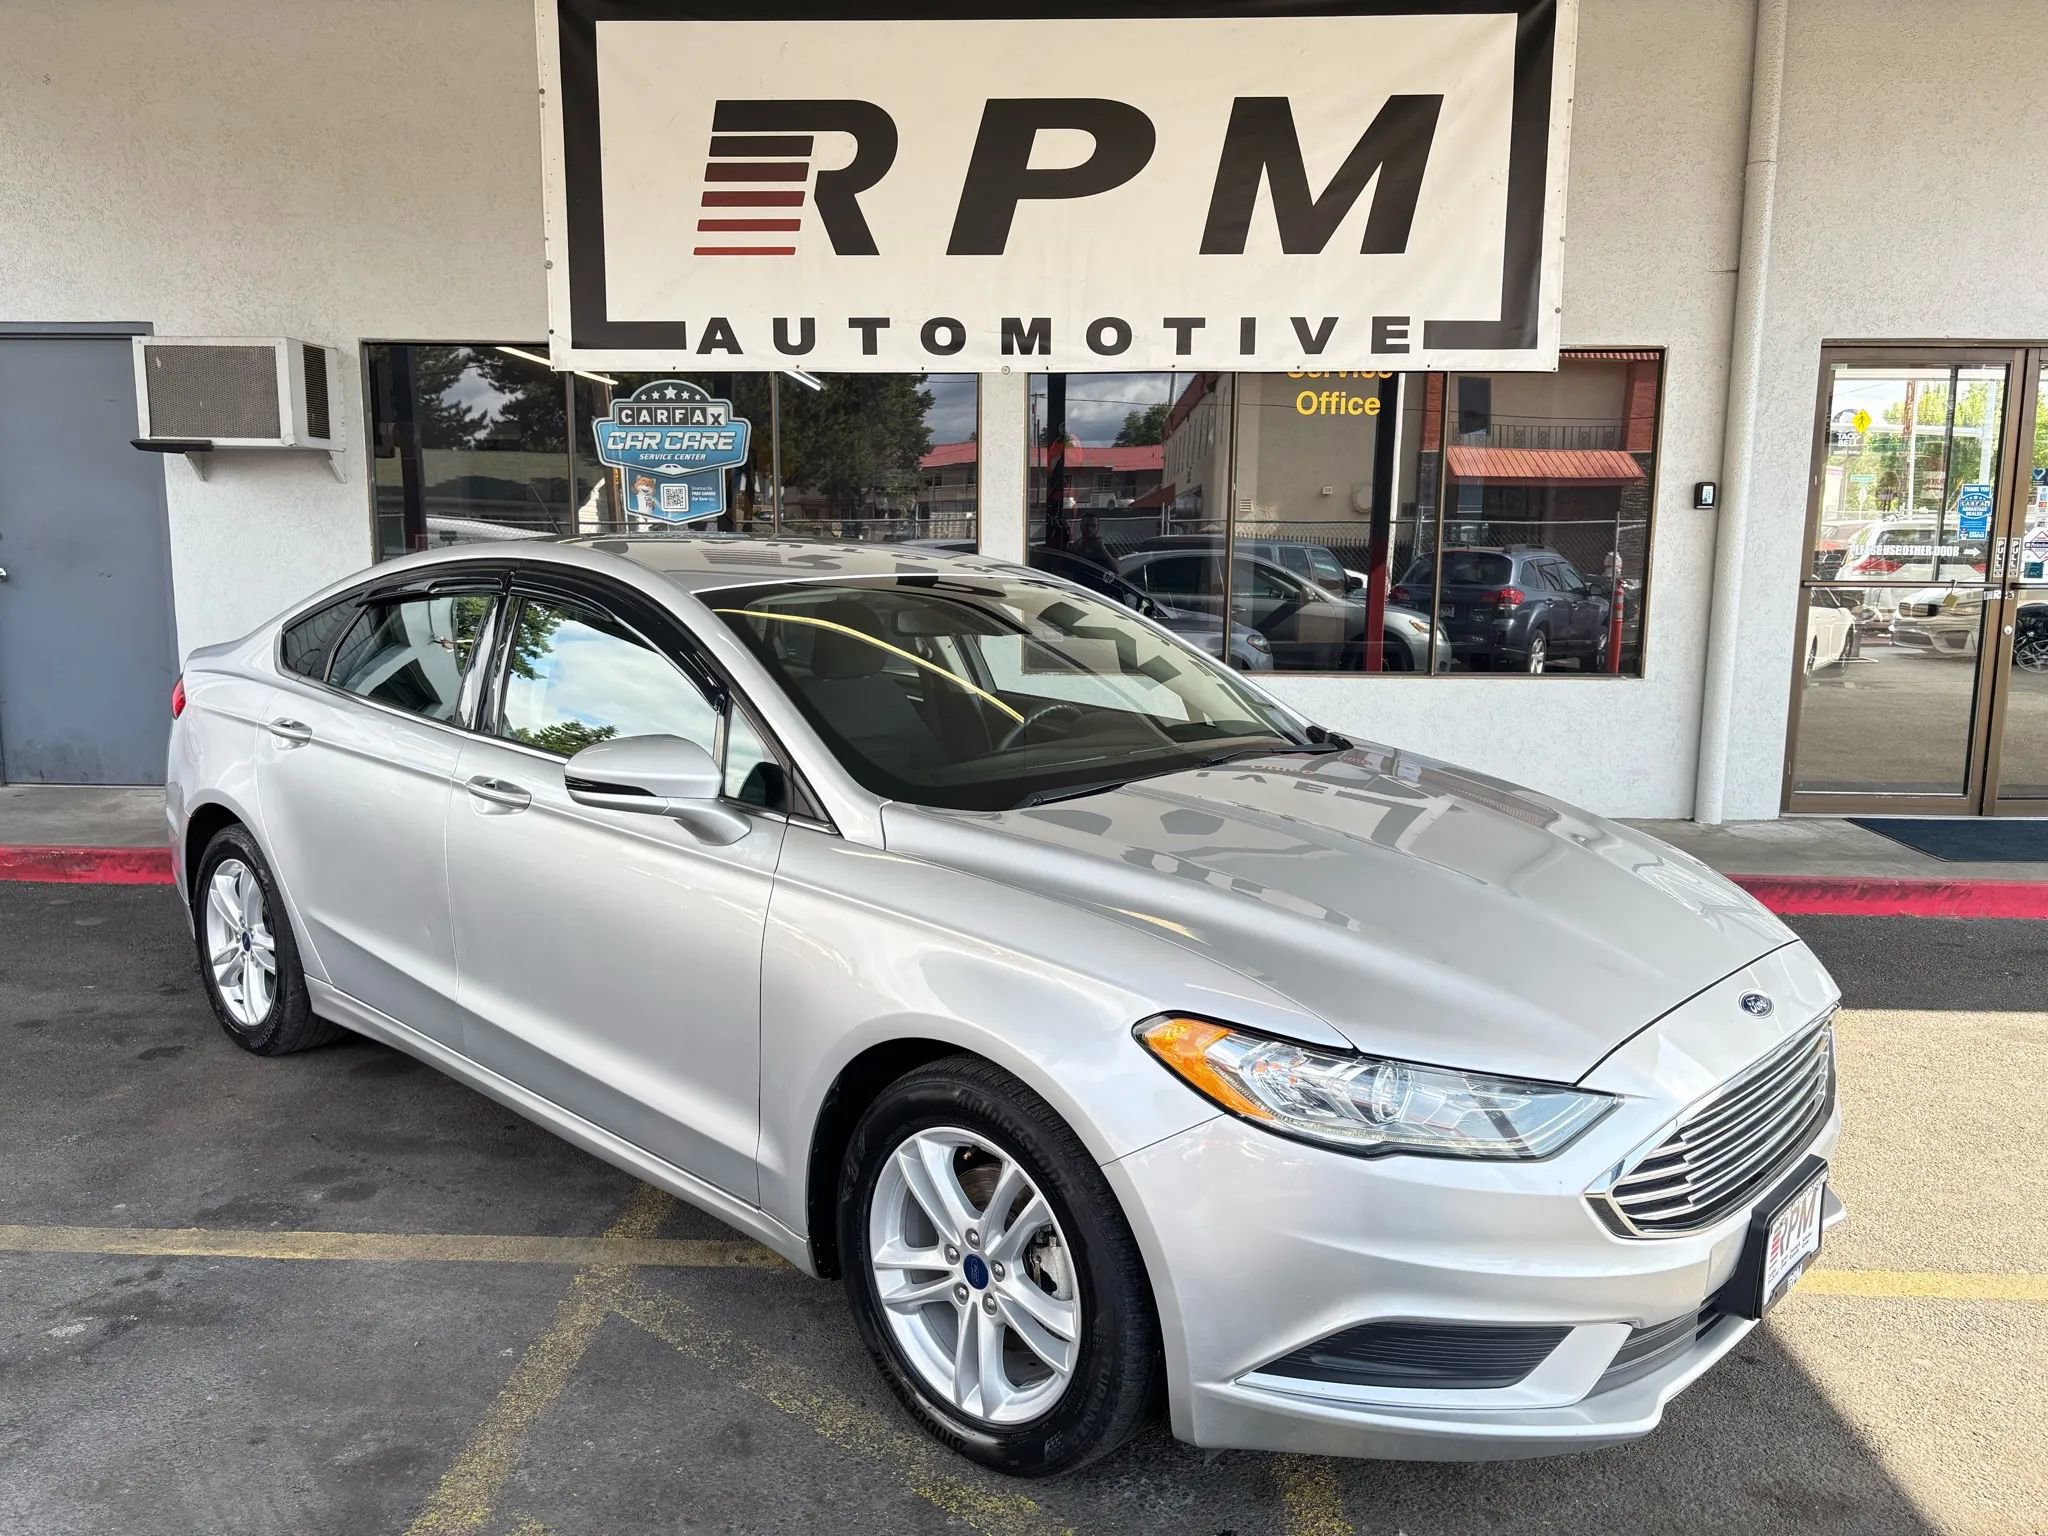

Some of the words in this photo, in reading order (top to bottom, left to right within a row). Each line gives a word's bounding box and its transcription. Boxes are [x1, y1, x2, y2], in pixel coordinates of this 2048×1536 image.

[693, 93, 1444, 256] RPM
[697, 316, 1411, 356] AUTOMOTIVE
[1296, 390, 1381, 416] Office
[621, 408, 723, 426] CARFAX
[607, 432, 662, 450] CAR
[664, 431, 736, 450] CARE
[1851, 545, 1883, 556] PLEASE
[1883, 545, 1902, 556] USE
[1902, 545, 1932, 556] OTHER
[1934, 545, 1960, 557] DOOR
[1997, 540, 2005, 567] PULL
[2011, 540, 2019, 567] PULL
[1769, 1189, 1818, 1268] RPM
